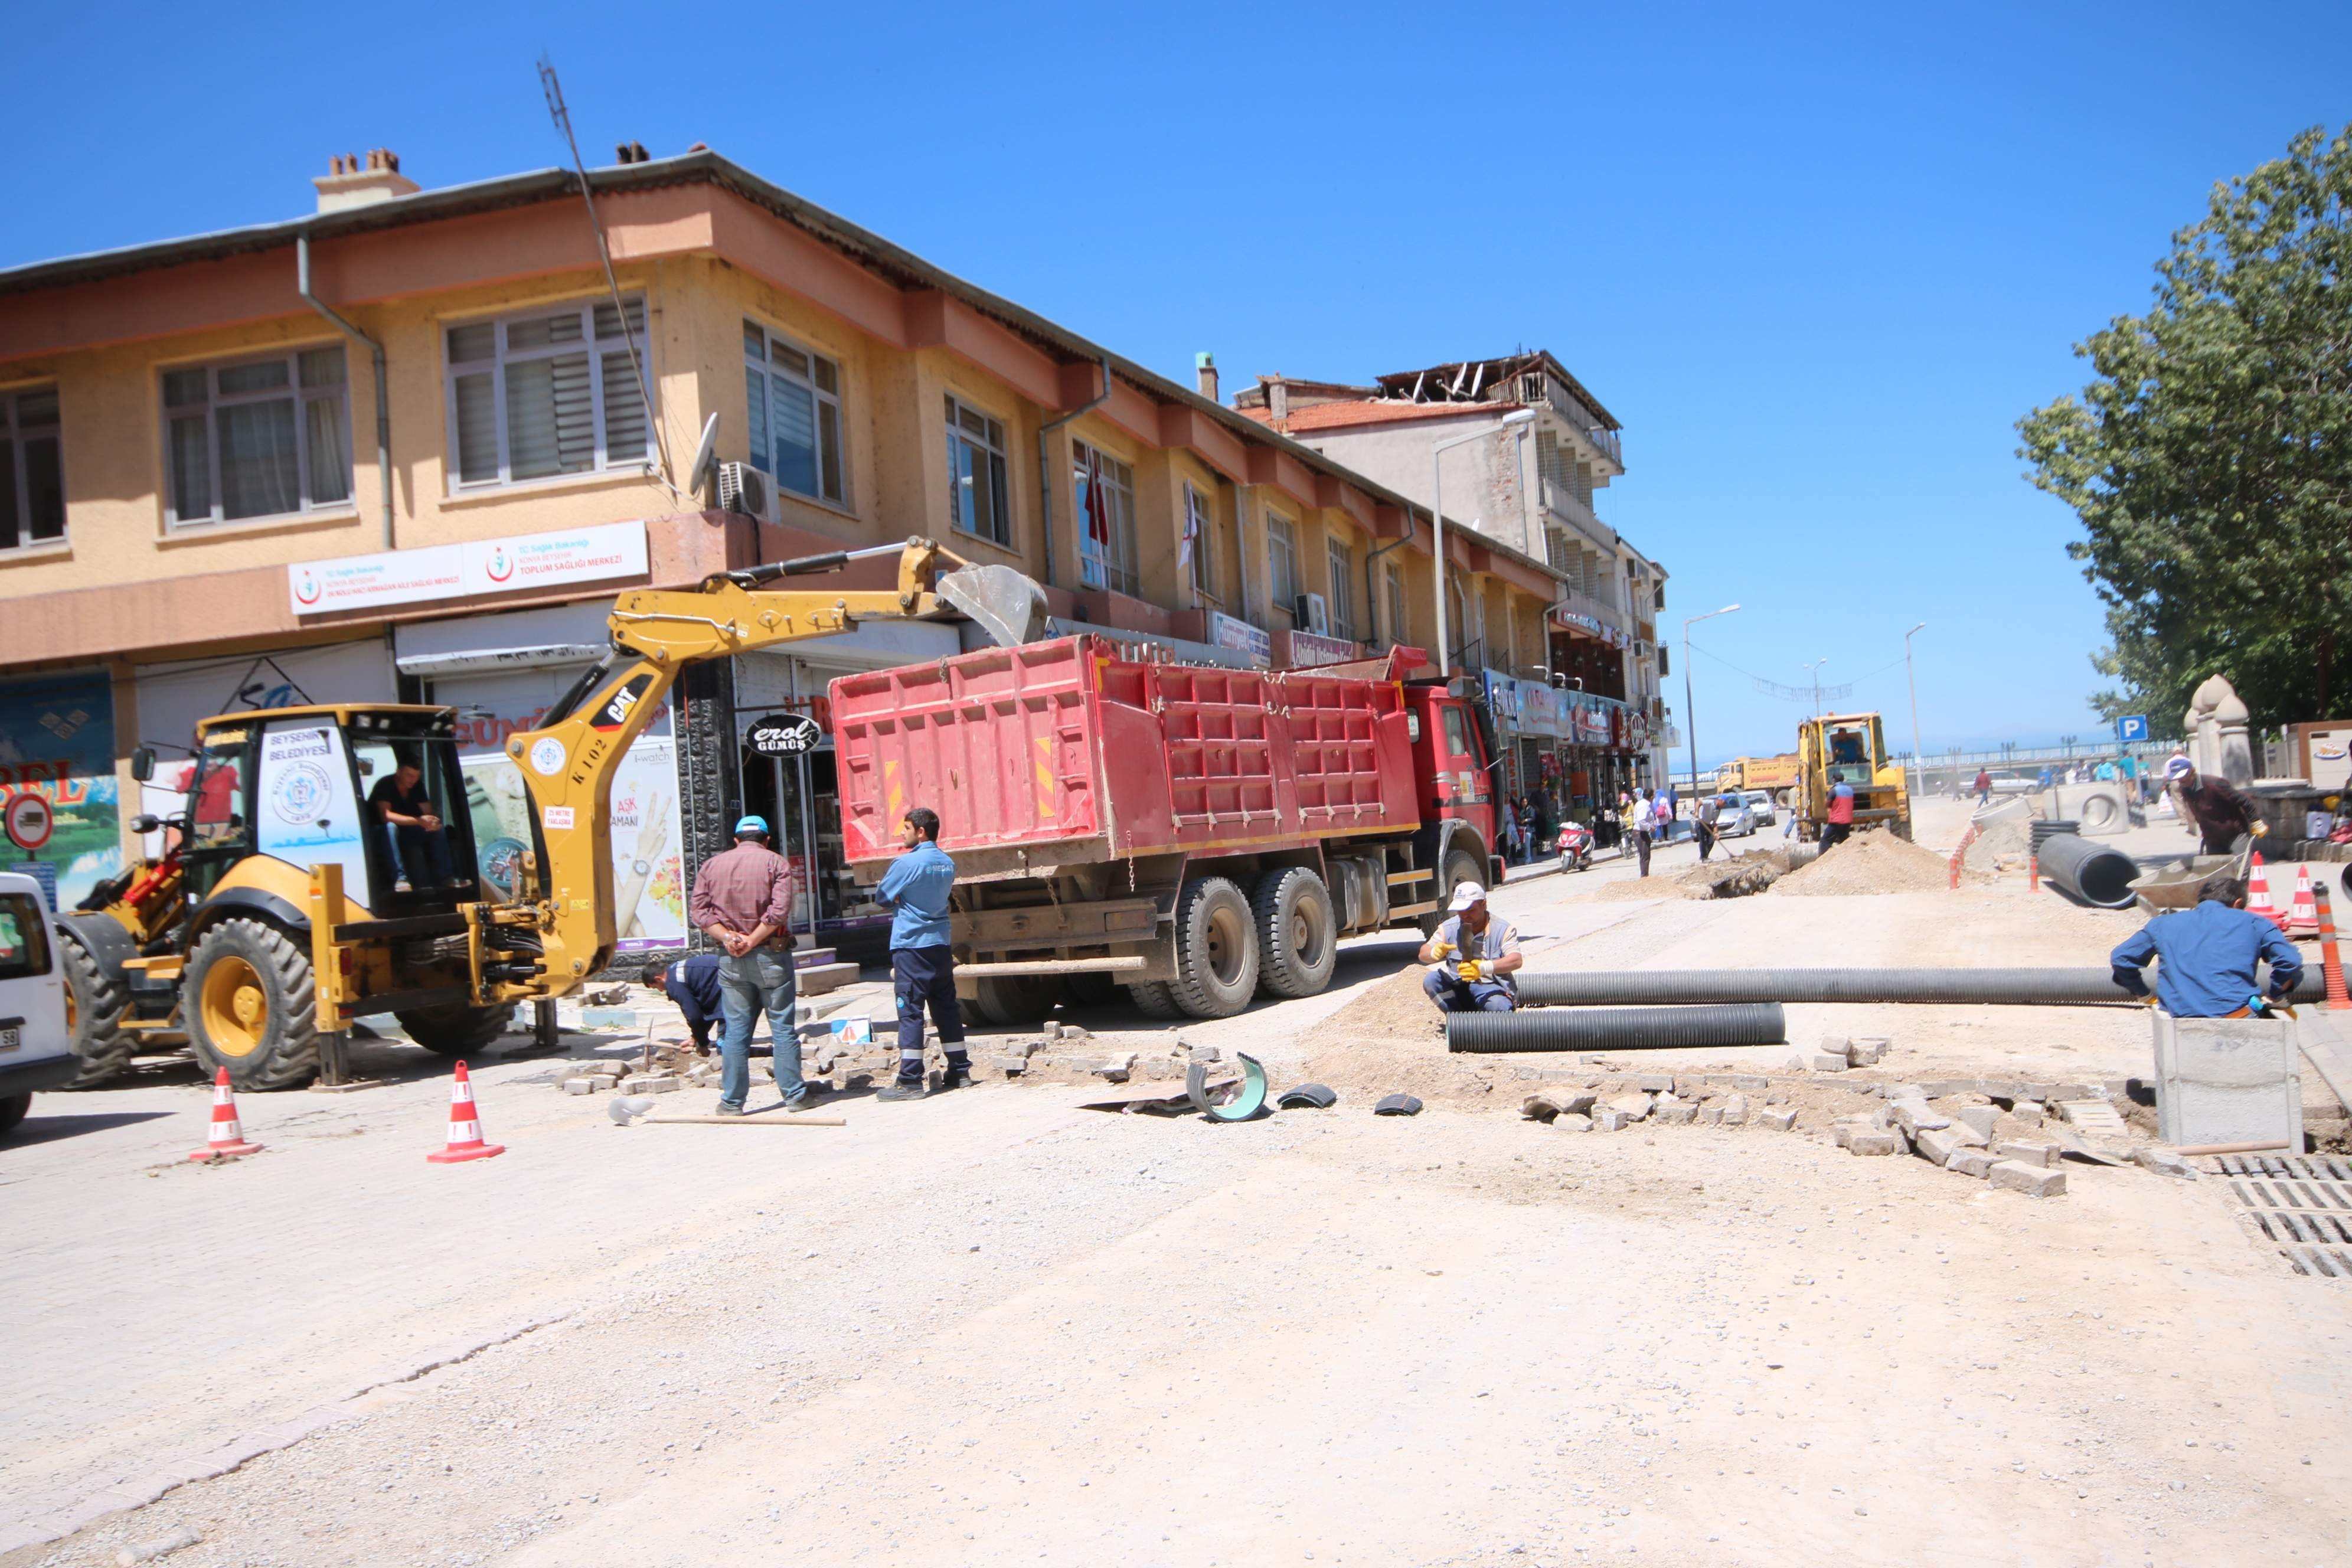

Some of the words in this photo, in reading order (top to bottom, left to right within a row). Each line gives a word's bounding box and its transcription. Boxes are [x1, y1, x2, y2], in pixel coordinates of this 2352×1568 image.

[520, 564, 553, 575] TOPLUM
[554, 560, 586, 571] SAĞLIĞI
[587, 553, 622, 567] MERKEZİ
[607, 686, 638, 723] CAT
[754, 720, 809, 741] erol
[2124, 719, 2140, 737] P
[757, 739, 806, 751] GÜMÜŞ
[571, 772, 586, 785] K
[582, 739, 607, 770] 102
[617, 797, 638, 814] AŞK
[610, 815, 639, 827] AMANI
[2, 1030, 15, 1044] 58
